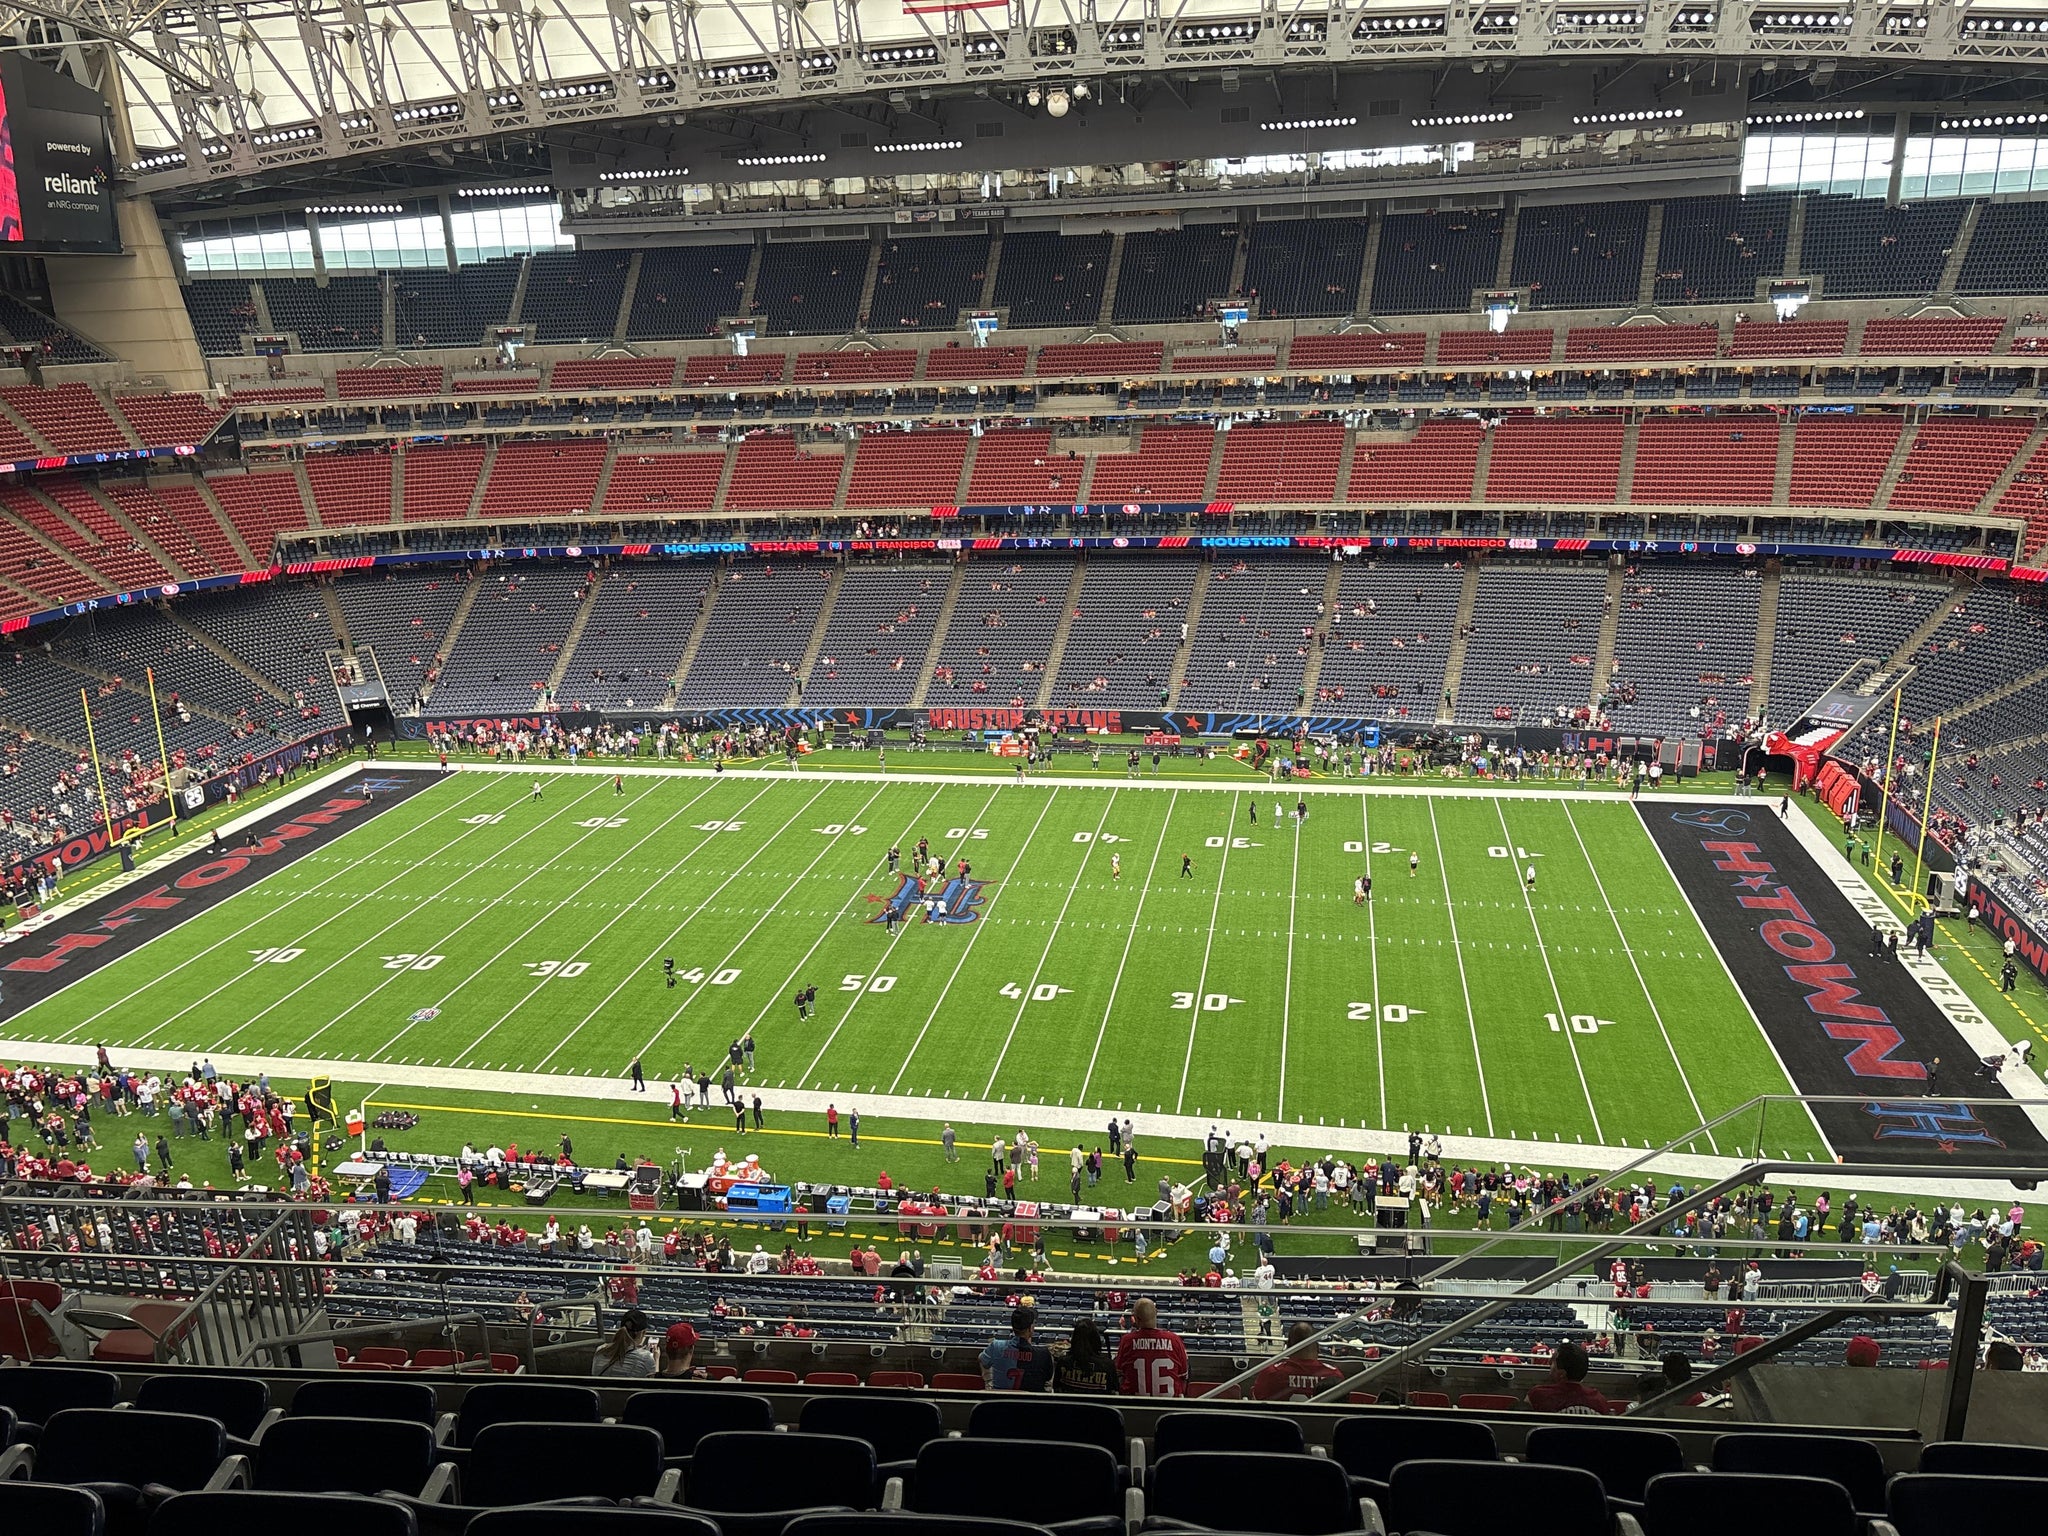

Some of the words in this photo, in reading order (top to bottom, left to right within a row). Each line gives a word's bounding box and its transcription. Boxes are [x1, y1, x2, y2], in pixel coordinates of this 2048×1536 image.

[47, 142, 80, 153] powered
[81, 144, 91, 156] by
[44, 173, 98, 195] reliant
[47, 200, 56, 209] an
[56, 201, 71, 209] NRG
[72, 203, 99, 212] company
[664, 543, 746, 554] HOUSTON
[750, 542, 819, 551] TEXANS
[851, 541, 873, 550] SAN
[875, 541, 936, 549] FRANCISCO
[1201, 537, 1290, 547] HOUSTON
[1295, 537, 1371, 547] TEXANS
[1408, 538, 1433, 547] SAN
[1436, 538, 1507, 548] FRANCISCO
[929, 708, 1024, 730] HOUSTON
[1040, 709, 1121, 731] TEXANS
[1821, 721, 1849, 729] HYUNDAI
[64, 865, 157, 908] CHOOSE
[158, 835, 213, 866] LOVE
[1837, 879, 1867, 891] IT
[1852, 896, 1907, 937] TAKES
[252, 948, 307, 963] 10
[382, 953, 446, 970] 20
[528, 961, 593, 978] 30
[681, 967, 744, 986] 40
[837, 974, 898, 993] 50
[998, 982, 1060, 1001] 40
[1920, 976, 1960, 997] OF
[1169, 991, 1229, 1012] 30
[1346, 1001, 1410, 1023] 20
[1943, 1002, 1984, 1025] US
[1542, 1012, 1600, 1035] 10
[711, 1179, 722, 1190] G
[1616, 1271, 1626, 1282] 85
[1132, 1338, 1173, 1351] MONTANA
[1006, 1368, 1025, 1390] 7
[1133, 1358, 1175, 1397] 16
